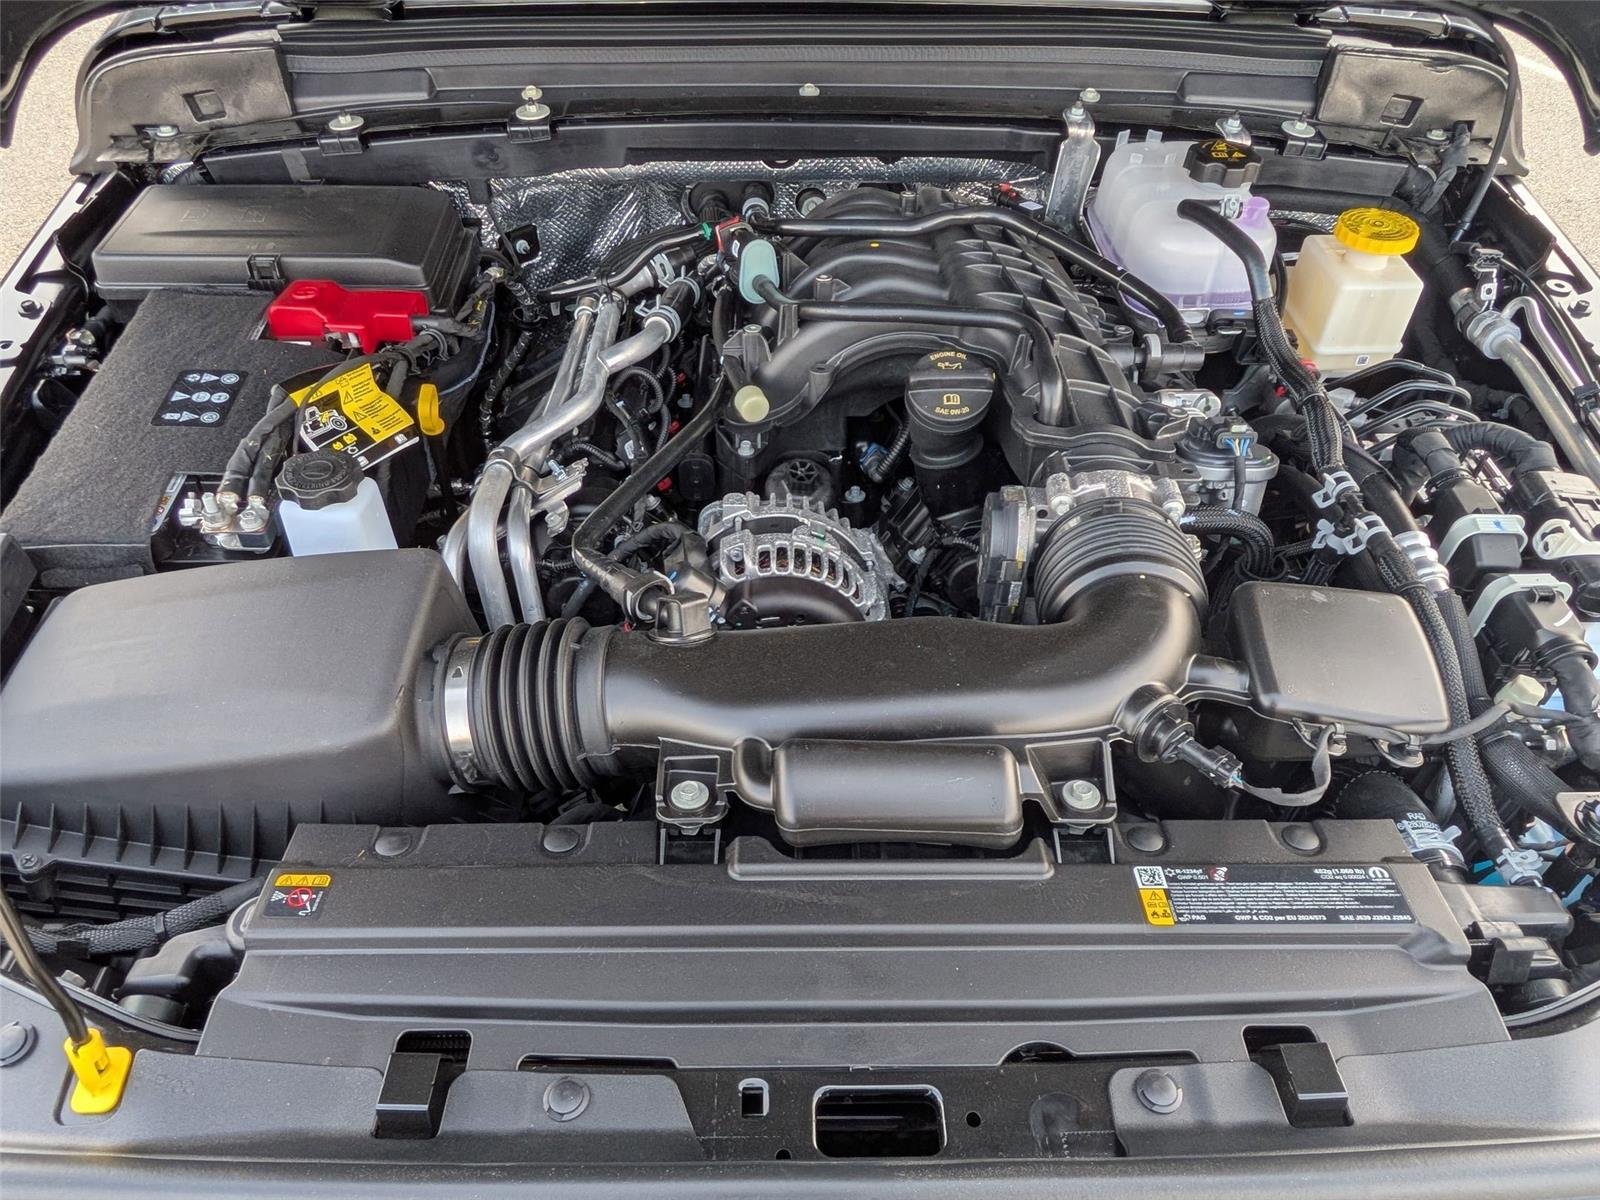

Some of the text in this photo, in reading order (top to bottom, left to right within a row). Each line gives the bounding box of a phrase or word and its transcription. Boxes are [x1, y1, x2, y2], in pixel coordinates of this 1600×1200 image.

[930, 351, 968, 361] ENGINE OIL
[935, 406, 950, 415] SAE
